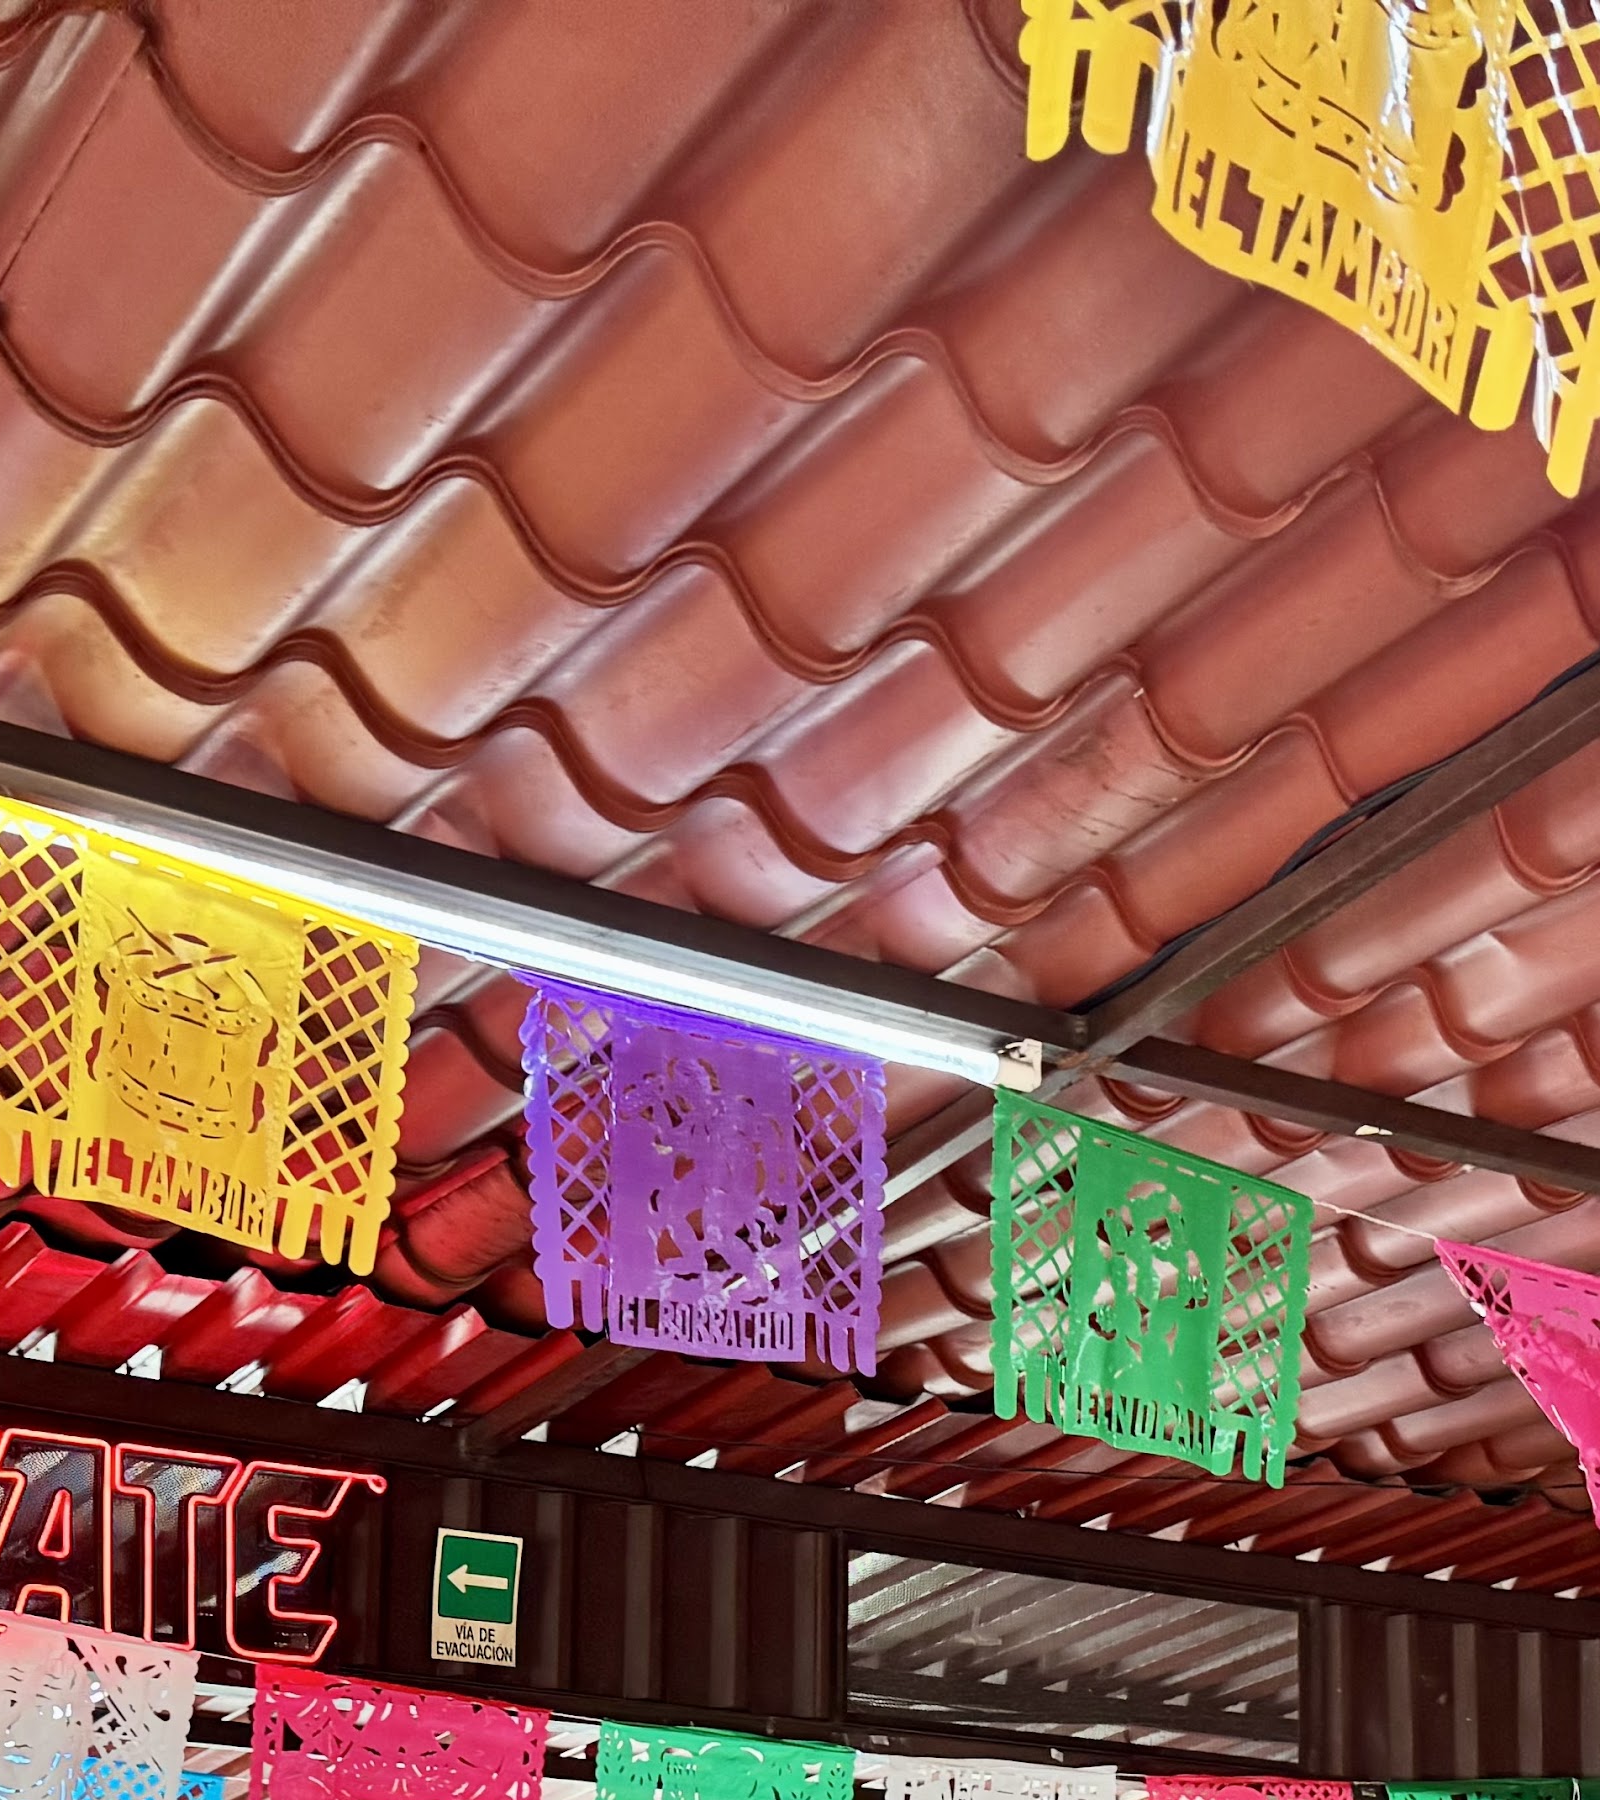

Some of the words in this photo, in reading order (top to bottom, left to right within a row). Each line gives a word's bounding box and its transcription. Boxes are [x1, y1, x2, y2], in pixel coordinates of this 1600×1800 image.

[1180, 138, 1246, 254] EL
[1247, 172, 1454, 382] TAMBOR
[79, 1136, 124, 1194] EL
[122, 1147, 268, 1237] TAMBOR
[622, 1297, 659, 1336] EL
[660, 1299, 791, 1351] BORRACHO
[1080, 1384, 1113, 1432] EL
[1113, 1394, 1205, 1457] NOPAL
[436, 1640, 513, 1663] EVACUACIÓN
[455, 1621, 475, 1641] VÍA
[479, 1627, 496, 1643] DE
